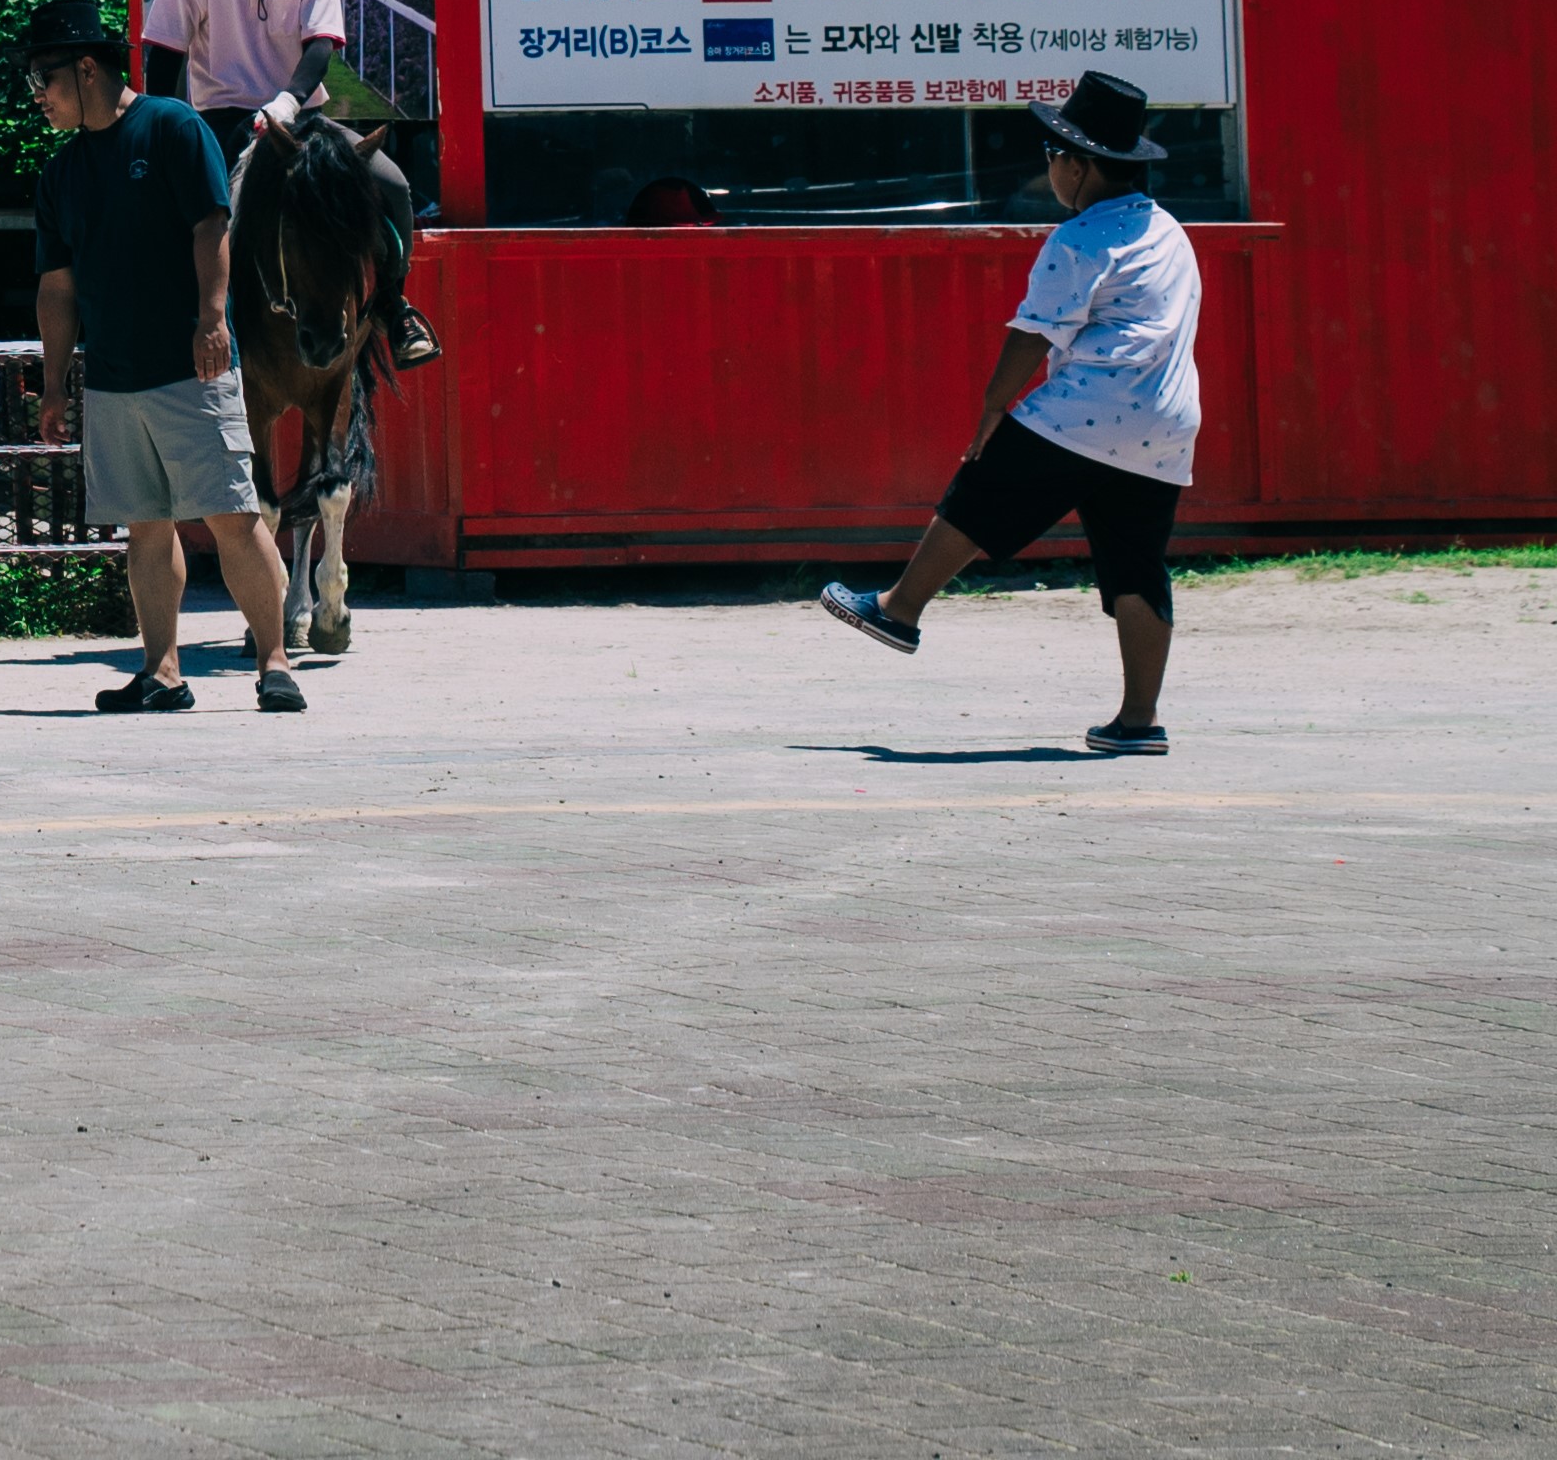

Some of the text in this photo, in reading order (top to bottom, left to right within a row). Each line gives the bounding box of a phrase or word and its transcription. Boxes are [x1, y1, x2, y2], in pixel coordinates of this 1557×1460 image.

[519, 23, 1198, 59] 장거리(B)코스 는 모자와 신발 착용 (7세이상 체험가능)
[707, 47, 721, 55] 승마
[833, 78, 915, 104] 귀중품등
[924, 77, 1005, 102] 보관함에
[1016, 80, 1075, 101] 보관하
[826, 599, 864, 629] crocs
